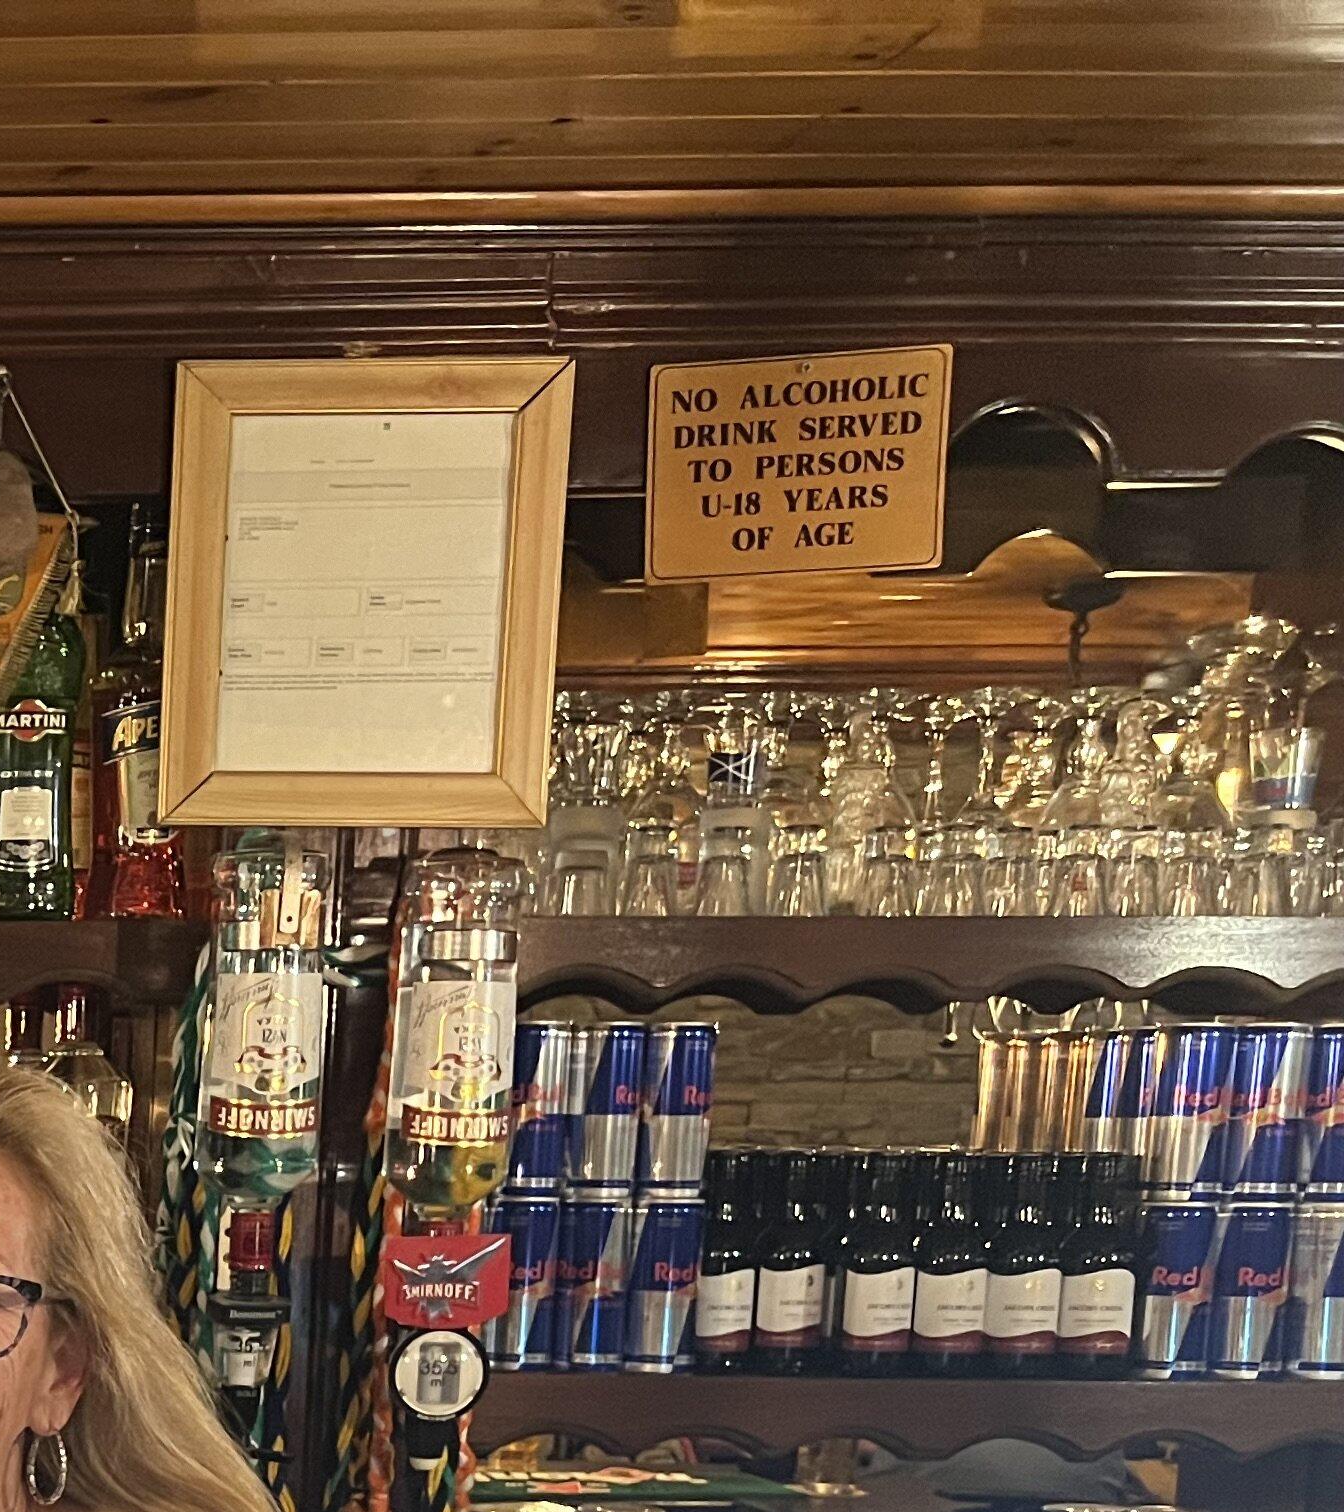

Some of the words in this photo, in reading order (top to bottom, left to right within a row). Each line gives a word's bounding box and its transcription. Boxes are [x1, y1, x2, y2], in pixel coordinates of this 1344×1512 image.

[672, 388, 718, 415] NO
[739, 373, 930, 410] ALCOHOLIC
[674, 419, 777, 449] DRINK
[798, 410, 923, 441] SERVED
[687, 458, 732, 483] TO
[755, 447, 905, 480] PERSONS
[700, 491, 761, 519] U-18
[784, 484, 889, 514] YEARS
[732, 526, 774, 552] OF
[793, 521, 855, 548] AGE
[216, 1104, 316, 1134] SMIRNOFF
[408, 1111, 510, 1141] SMIRNOFF
[654, 1261, 696, 1282] Red
[1152, 1265, 1198, 1287] Red
[1238, 1265, 1282, 1287] Red
[403, 1283, 472, 1301] SMIRNOFF
